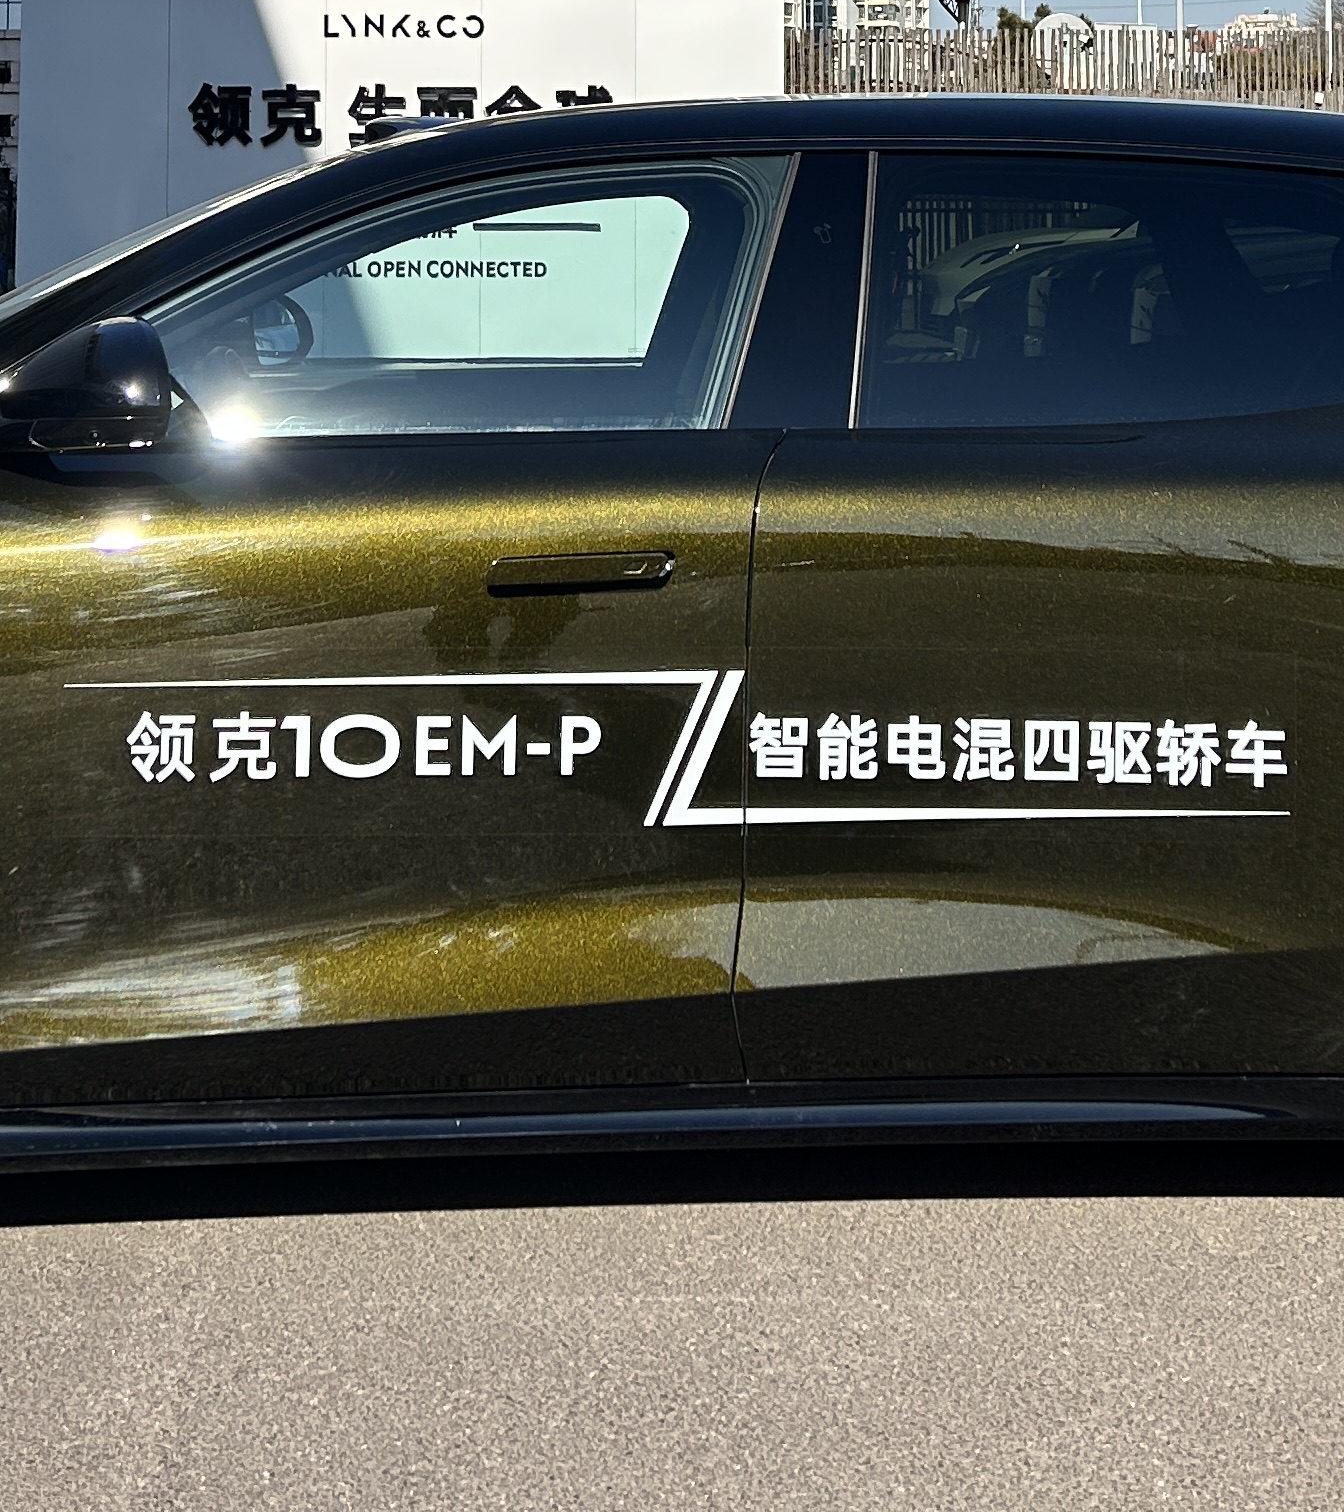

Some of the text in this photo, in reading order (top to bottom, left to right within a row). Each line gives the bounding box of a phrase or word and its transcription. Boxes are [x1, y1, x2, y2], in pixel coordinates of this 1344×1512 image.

[323, 14, 485, 38] LYNK&CO
[188, 83, 322, 147] 领克
[367, 260, 421, 278] OPEN
[426, 260, 547, 278] CONNECTED
[749, 711, 1288, 788] 智能电混四驱轿车
